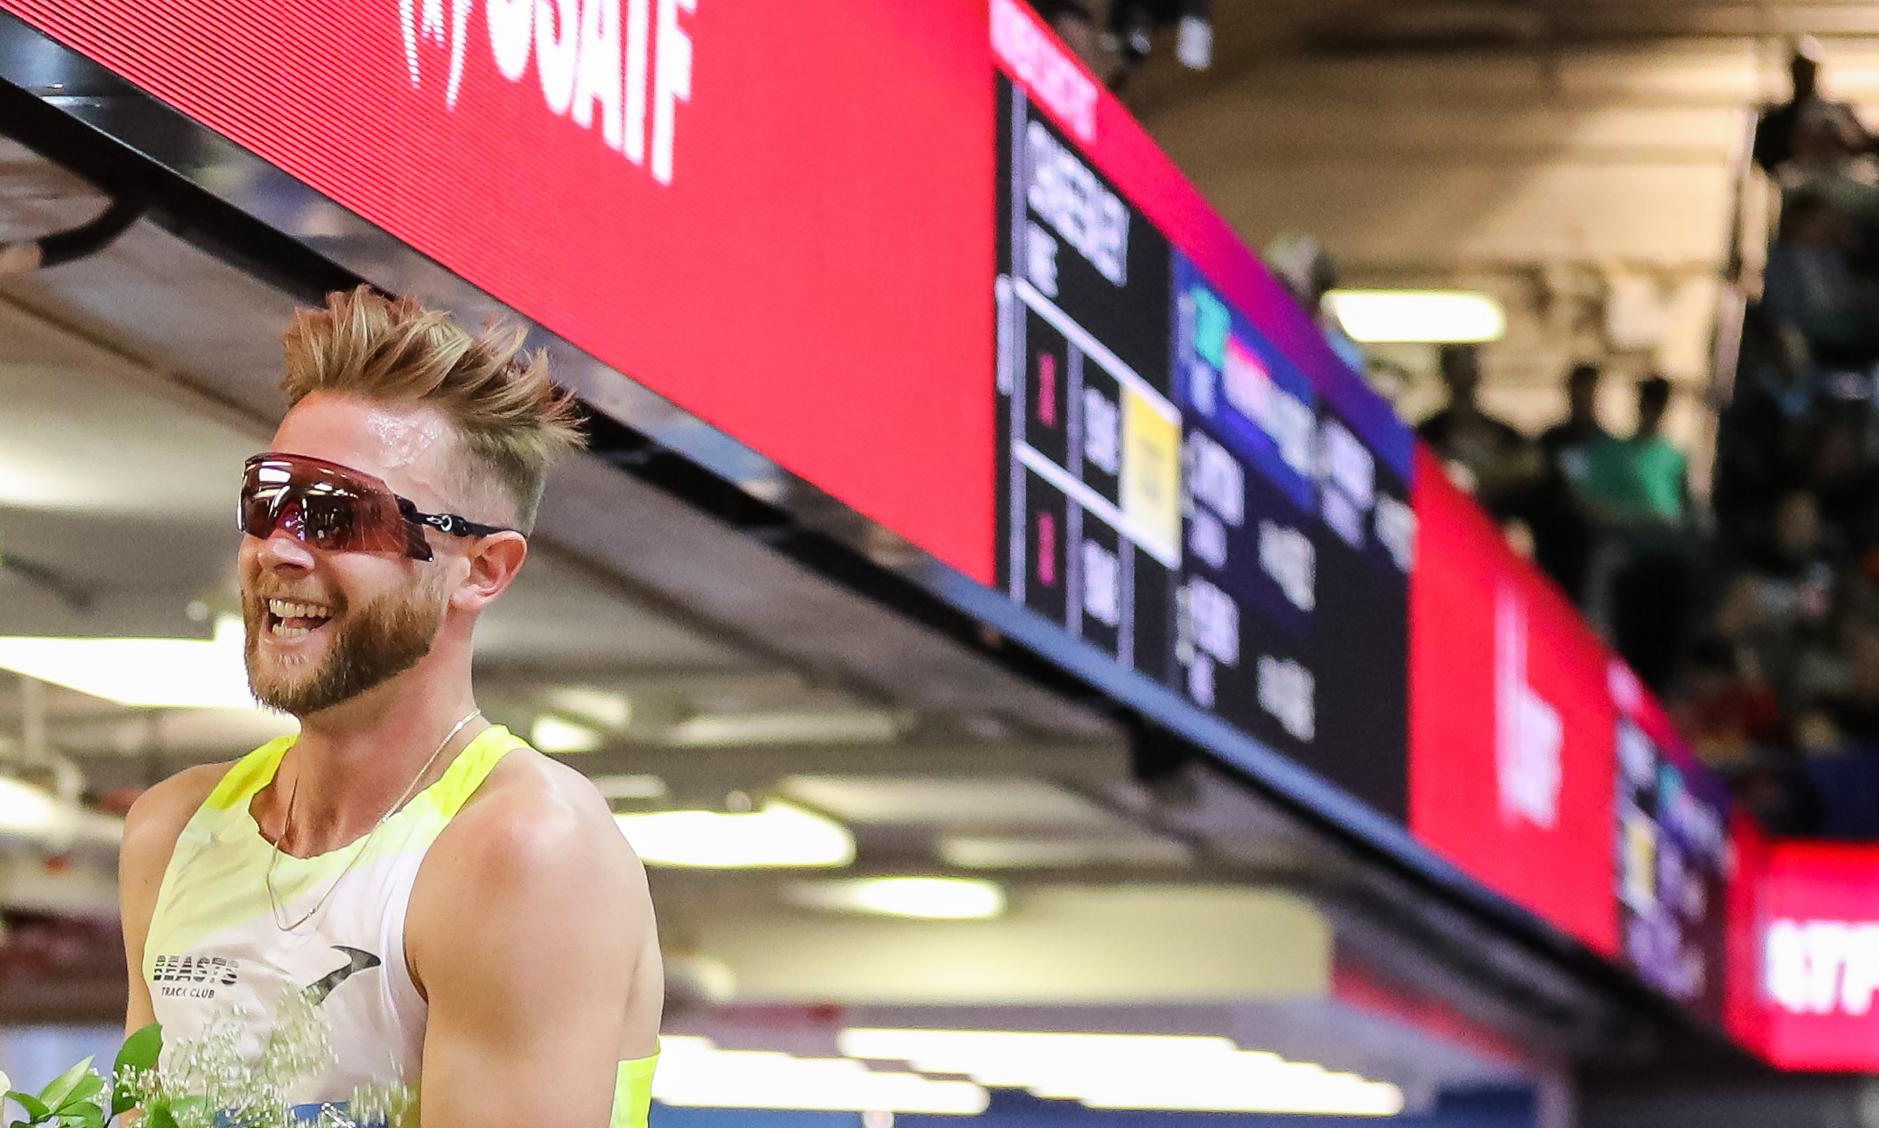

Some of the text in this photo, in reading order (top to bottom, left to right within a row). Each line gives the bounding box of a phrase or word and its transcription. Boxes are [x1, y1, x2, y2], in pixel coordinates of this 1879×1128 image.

[153, 955, 239, 985] BEASTS
[161, 986, 215, 999] TRACK CLUB
